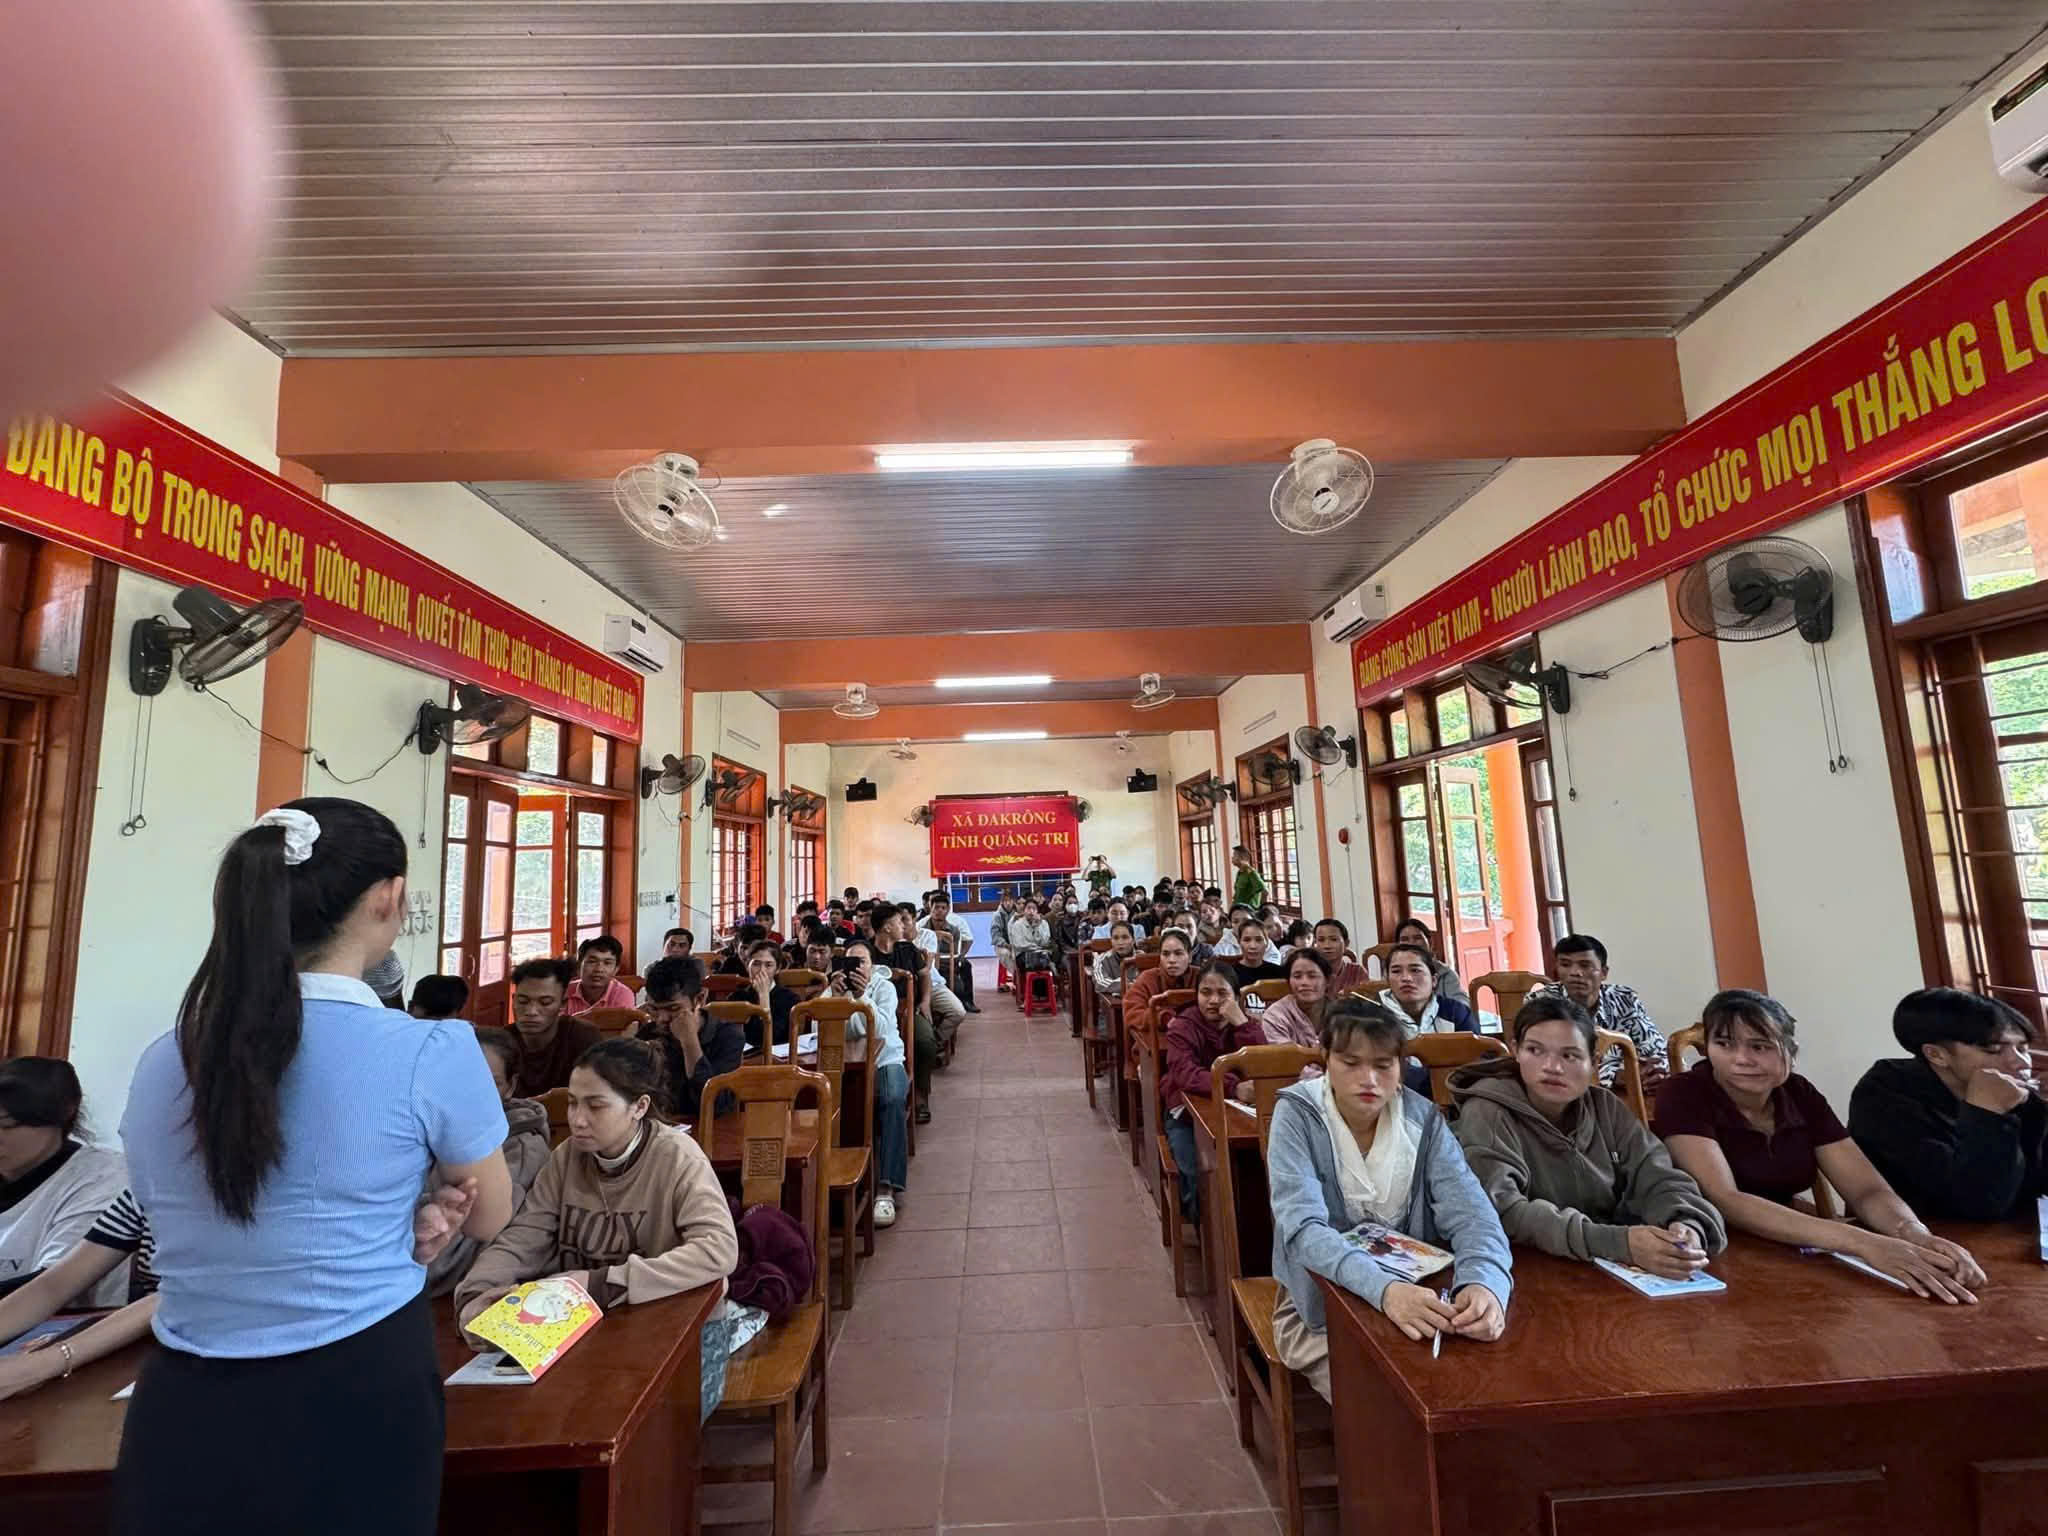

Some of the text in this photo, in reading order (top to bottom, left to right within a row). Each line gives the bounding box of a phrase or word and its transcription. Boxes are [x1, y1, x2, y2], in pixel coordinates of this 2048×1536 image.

[1381, 640, 1406, 681] CỘNG
[1406, 621, 1427, 666] SẢN
[1427, 611, 1450, 659] VIỆT
[1452, 596, 1481, 643] NAM
[1491, 560, 1538, 623] NGƯỜI
[1538, 544, 1586, 599] LÃNH
[1588, 513, 1638, 576] ĐẠO,
[1640, 471, 1671, 547] TỔ
[1675, 446, 1751, 529] CHỨC
[1756, 404, 1828, 486] MỌI
[1832, 321, 1986, 453] THẮNG
[111, 447, 154, 540] BỘ
[161, 470, 244, 563] TRONG
[248, 514, 307, 596] SẠCH,
[314, 541, 361, 612] VỮNG
[363, 567, 412, 638] MẠNH,
[416, 592, 456, 650] QUYẾT
[458, 607, 482, 662] TÂM
[484, 624, 510, 679] THỰC
[511, 635, 533, 687] HIỆN
[939, 830, 1070, 850] TỈNH QUẢNG TRỊ
[952, 811, 974, 828] XÃ
[560, 1204, 648, 1258] HOLY
